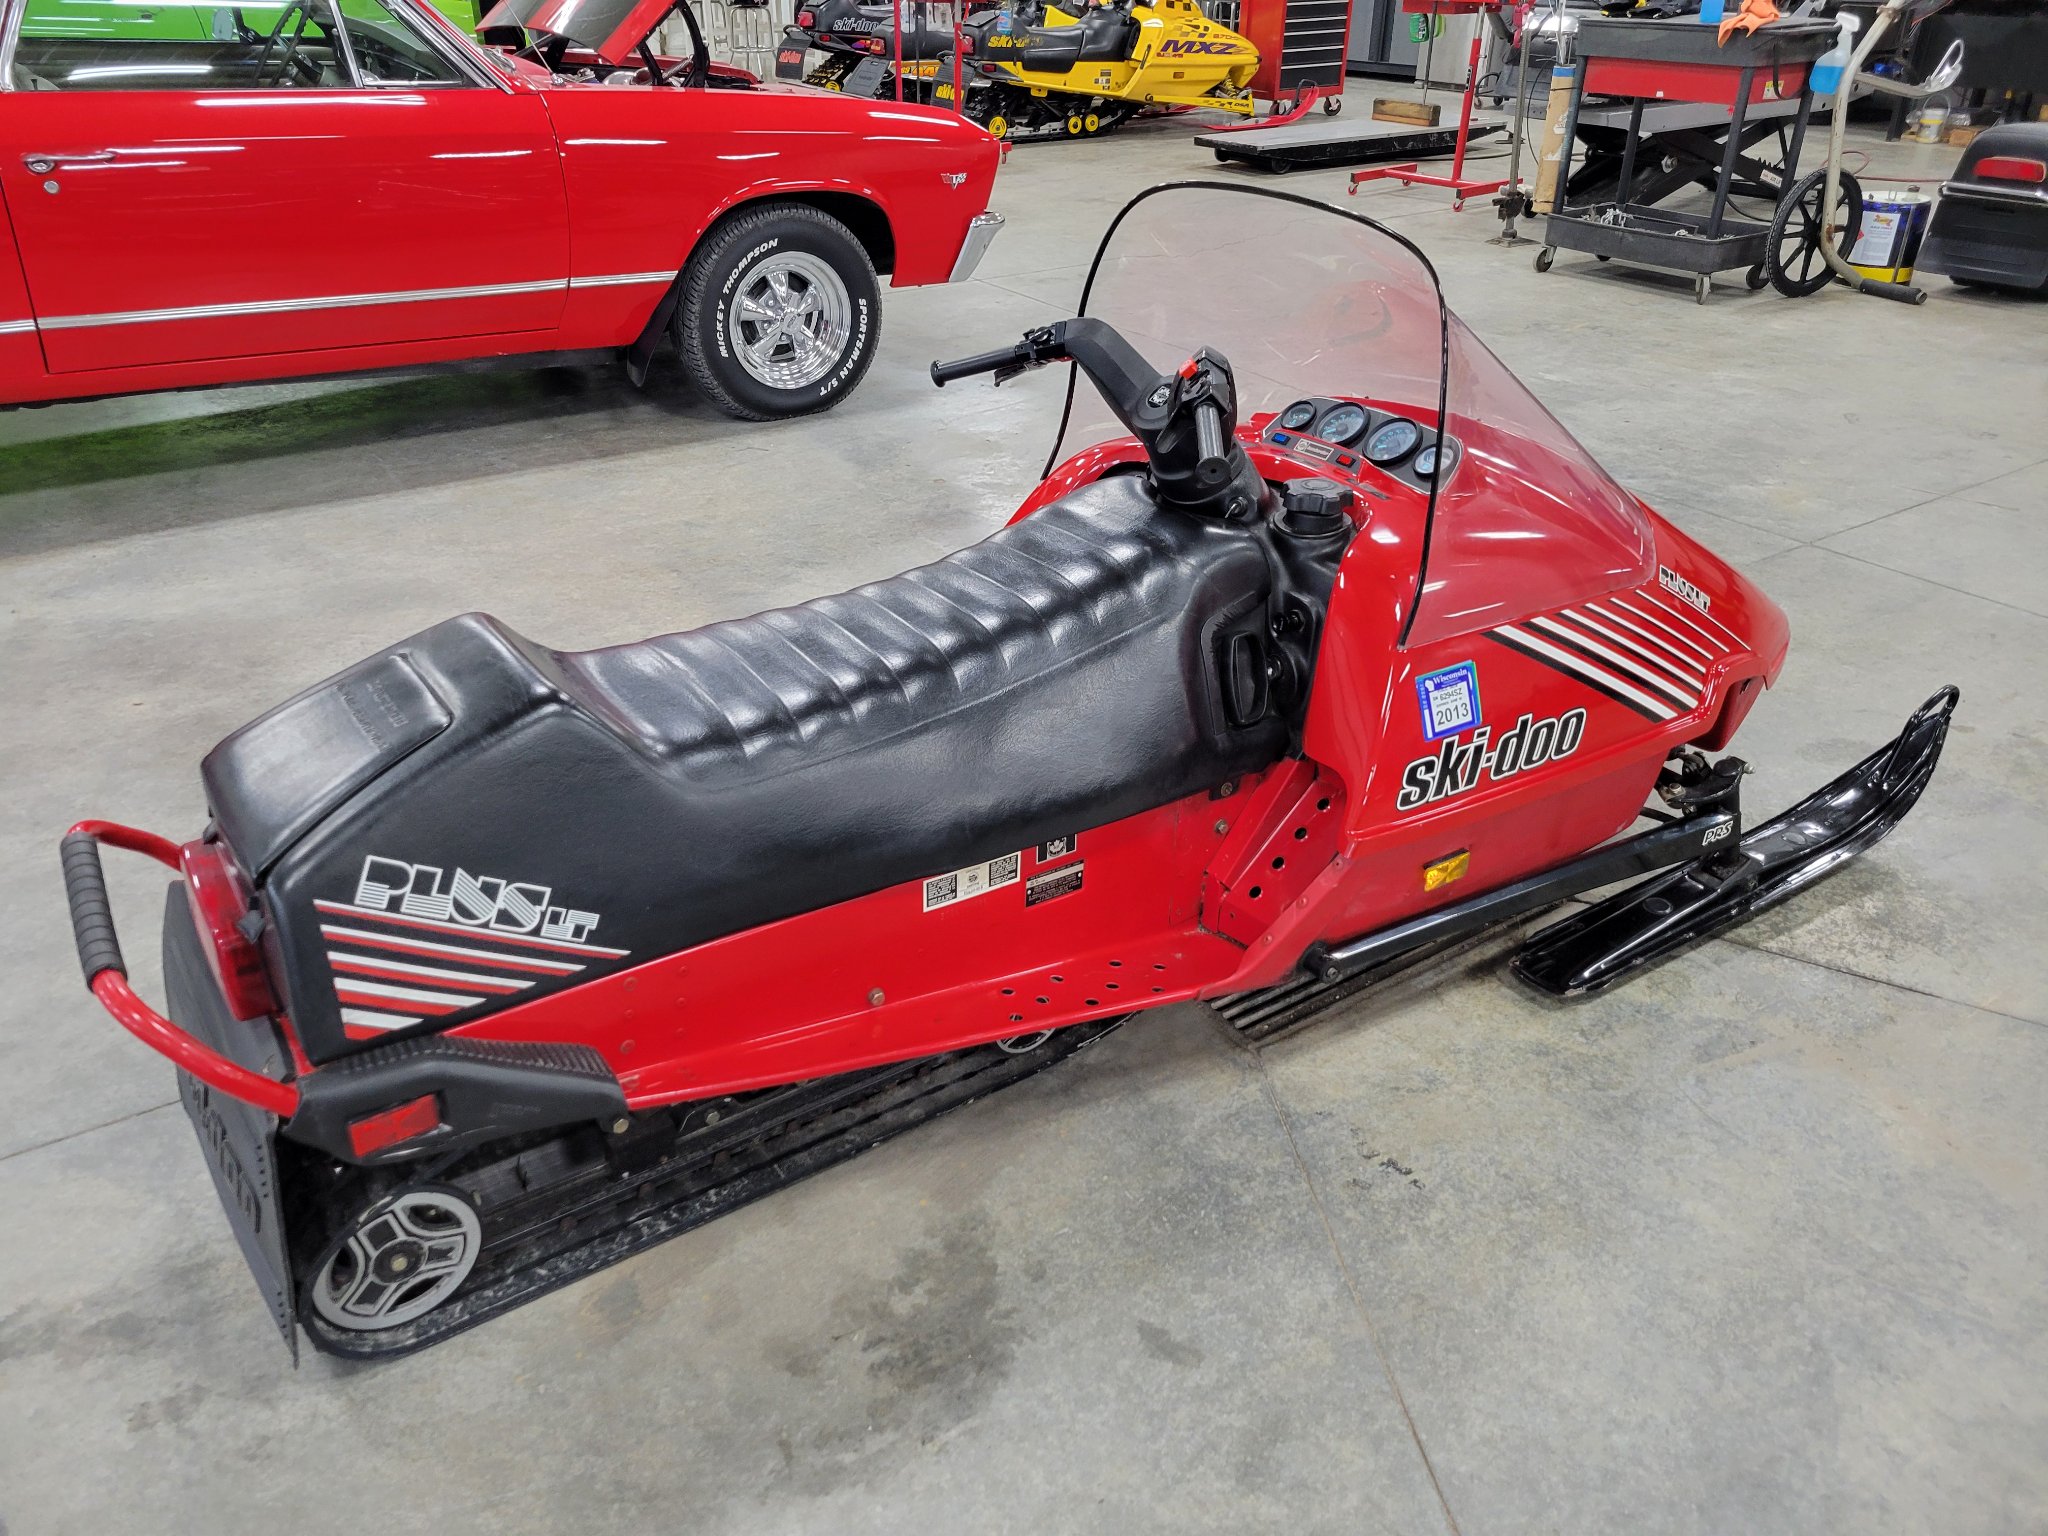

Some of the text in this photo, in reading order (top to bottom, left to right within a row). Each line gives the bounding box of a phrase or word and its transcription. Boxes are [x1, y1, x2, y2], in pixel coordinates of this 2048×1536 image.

[715, 237, 779, 358] MICKEY THOMPSON
[819, 298, 868, 397] SPORTSMAN S/T
[1432, 668, 1468, 685] Wisconsin
[1436, 702, 1469, 726] 2013
[1396, 707, 1587, 811] ski-doo
[1702, 820, 1734, 847] PRS
[354, 854, 601, 943] PLUS LT
